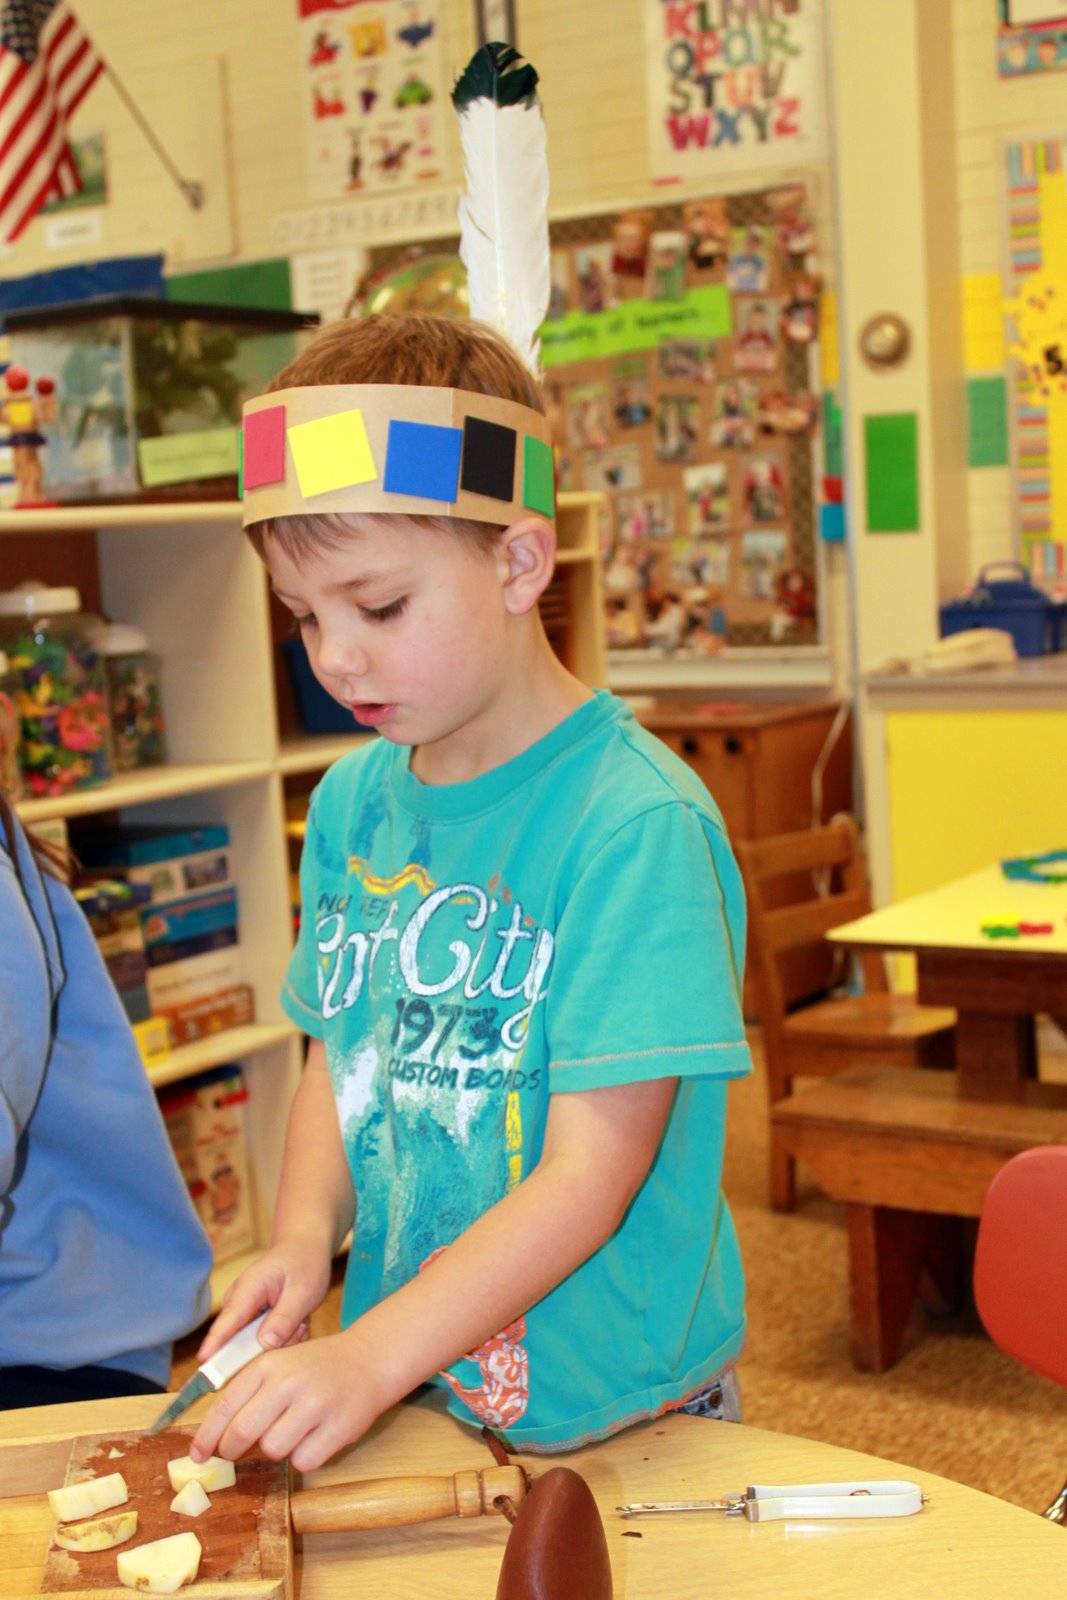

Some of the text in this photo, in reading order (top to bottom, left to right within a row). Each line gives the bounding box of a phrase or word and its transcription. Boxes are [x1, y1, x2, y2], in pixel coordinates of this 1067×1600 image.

[400, 882, 555, 1050] City
[390, 997, 501, 1060] 1973
[388, 1057, 459, 1091] CUSTOM
